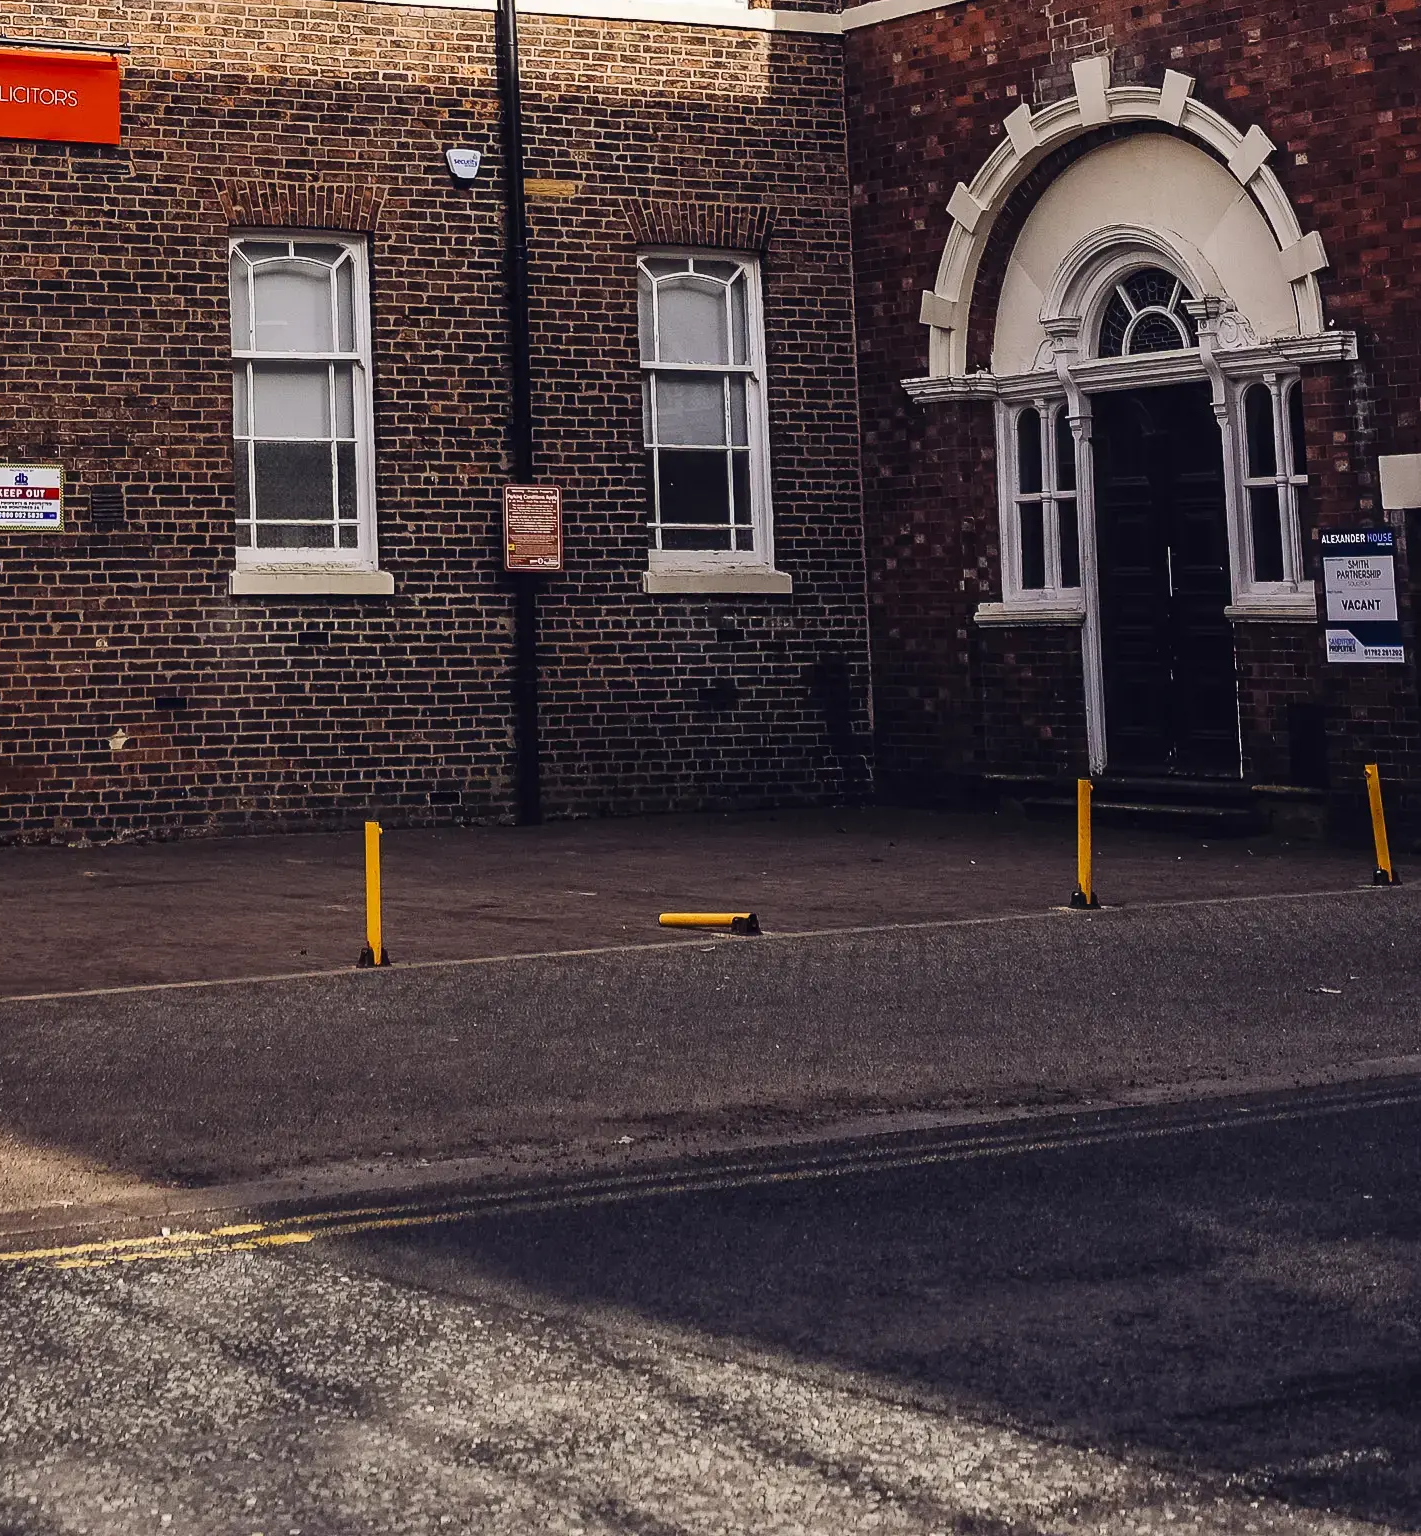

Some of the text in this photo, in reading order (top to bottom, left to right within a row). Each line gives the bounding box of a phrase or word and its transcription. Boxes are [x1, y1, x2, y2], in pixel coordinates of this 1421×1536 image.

[26, 489, 46, 498] OUT
[1321, 532, 1393, 544] ALEXANDER HOUSE
[1347, 559, 1370, 570] SMITH
[1336, 569, 1382, 580] PARTNERSHIP
[1341, 599, 1381, 611] VACANT
